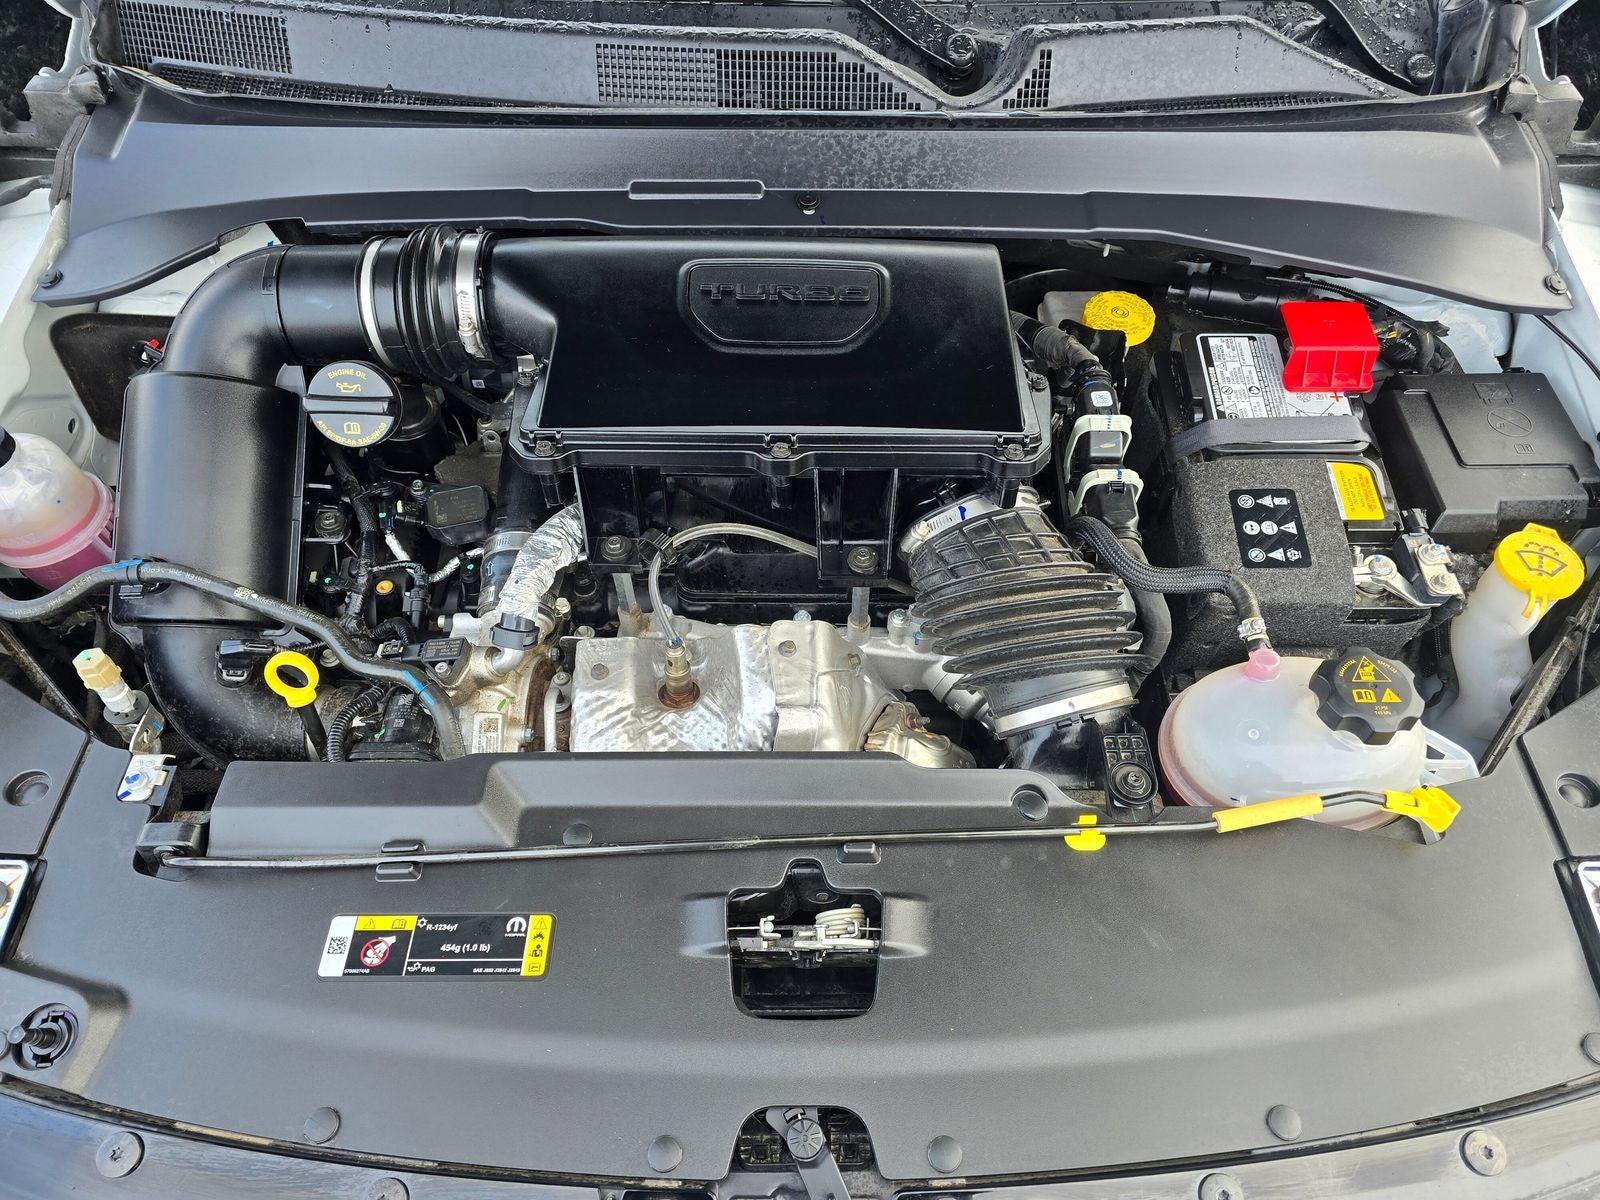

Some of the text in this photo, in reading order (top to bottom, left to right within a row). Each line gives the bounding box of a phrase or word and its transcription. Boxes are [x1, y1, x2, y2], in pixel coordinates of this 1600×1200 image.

[700, 283, 870, 301] TURBO
[328, 368, 367, 380] ENGINE OIL
[426, 923, 458, 932] R-1234yf
[440, 943, 491, 953] 454g (1.0 lb)
